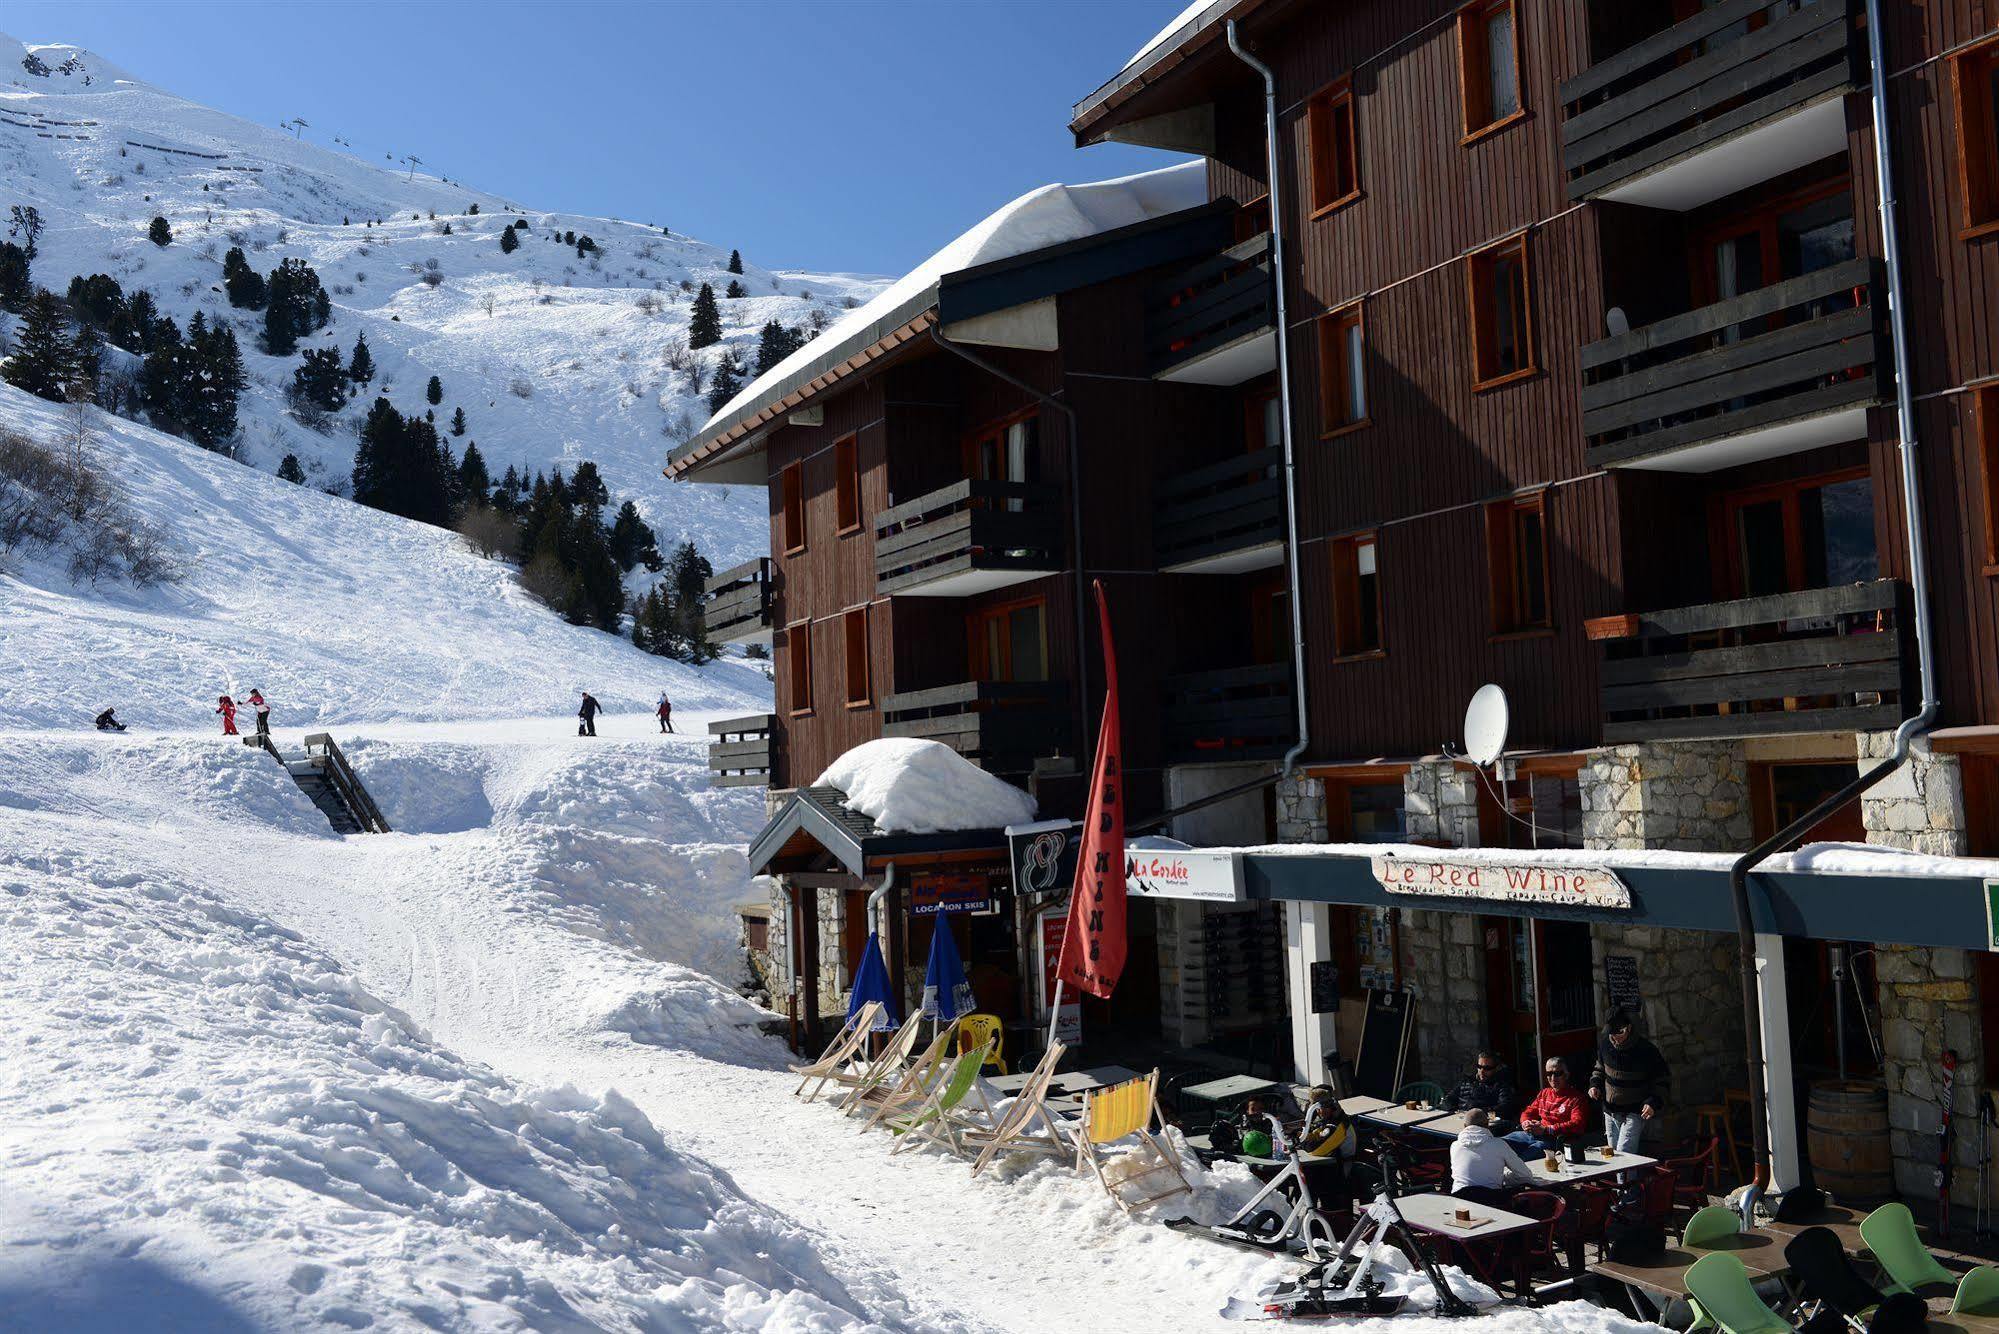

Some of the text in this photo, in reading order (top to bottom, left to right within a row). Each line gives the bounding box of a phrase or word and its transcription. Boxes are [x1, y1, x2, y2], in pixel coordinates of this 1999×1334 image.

[1100, 756, 1115, 832] RED
[1134, 857, 1188, 880] La Cordée
[1383, 861, 1586, 894] Le Red Wine
[915, 901, 985, 913] LOCAION SKIS
[1089, 852, 1109, 961] WINE
